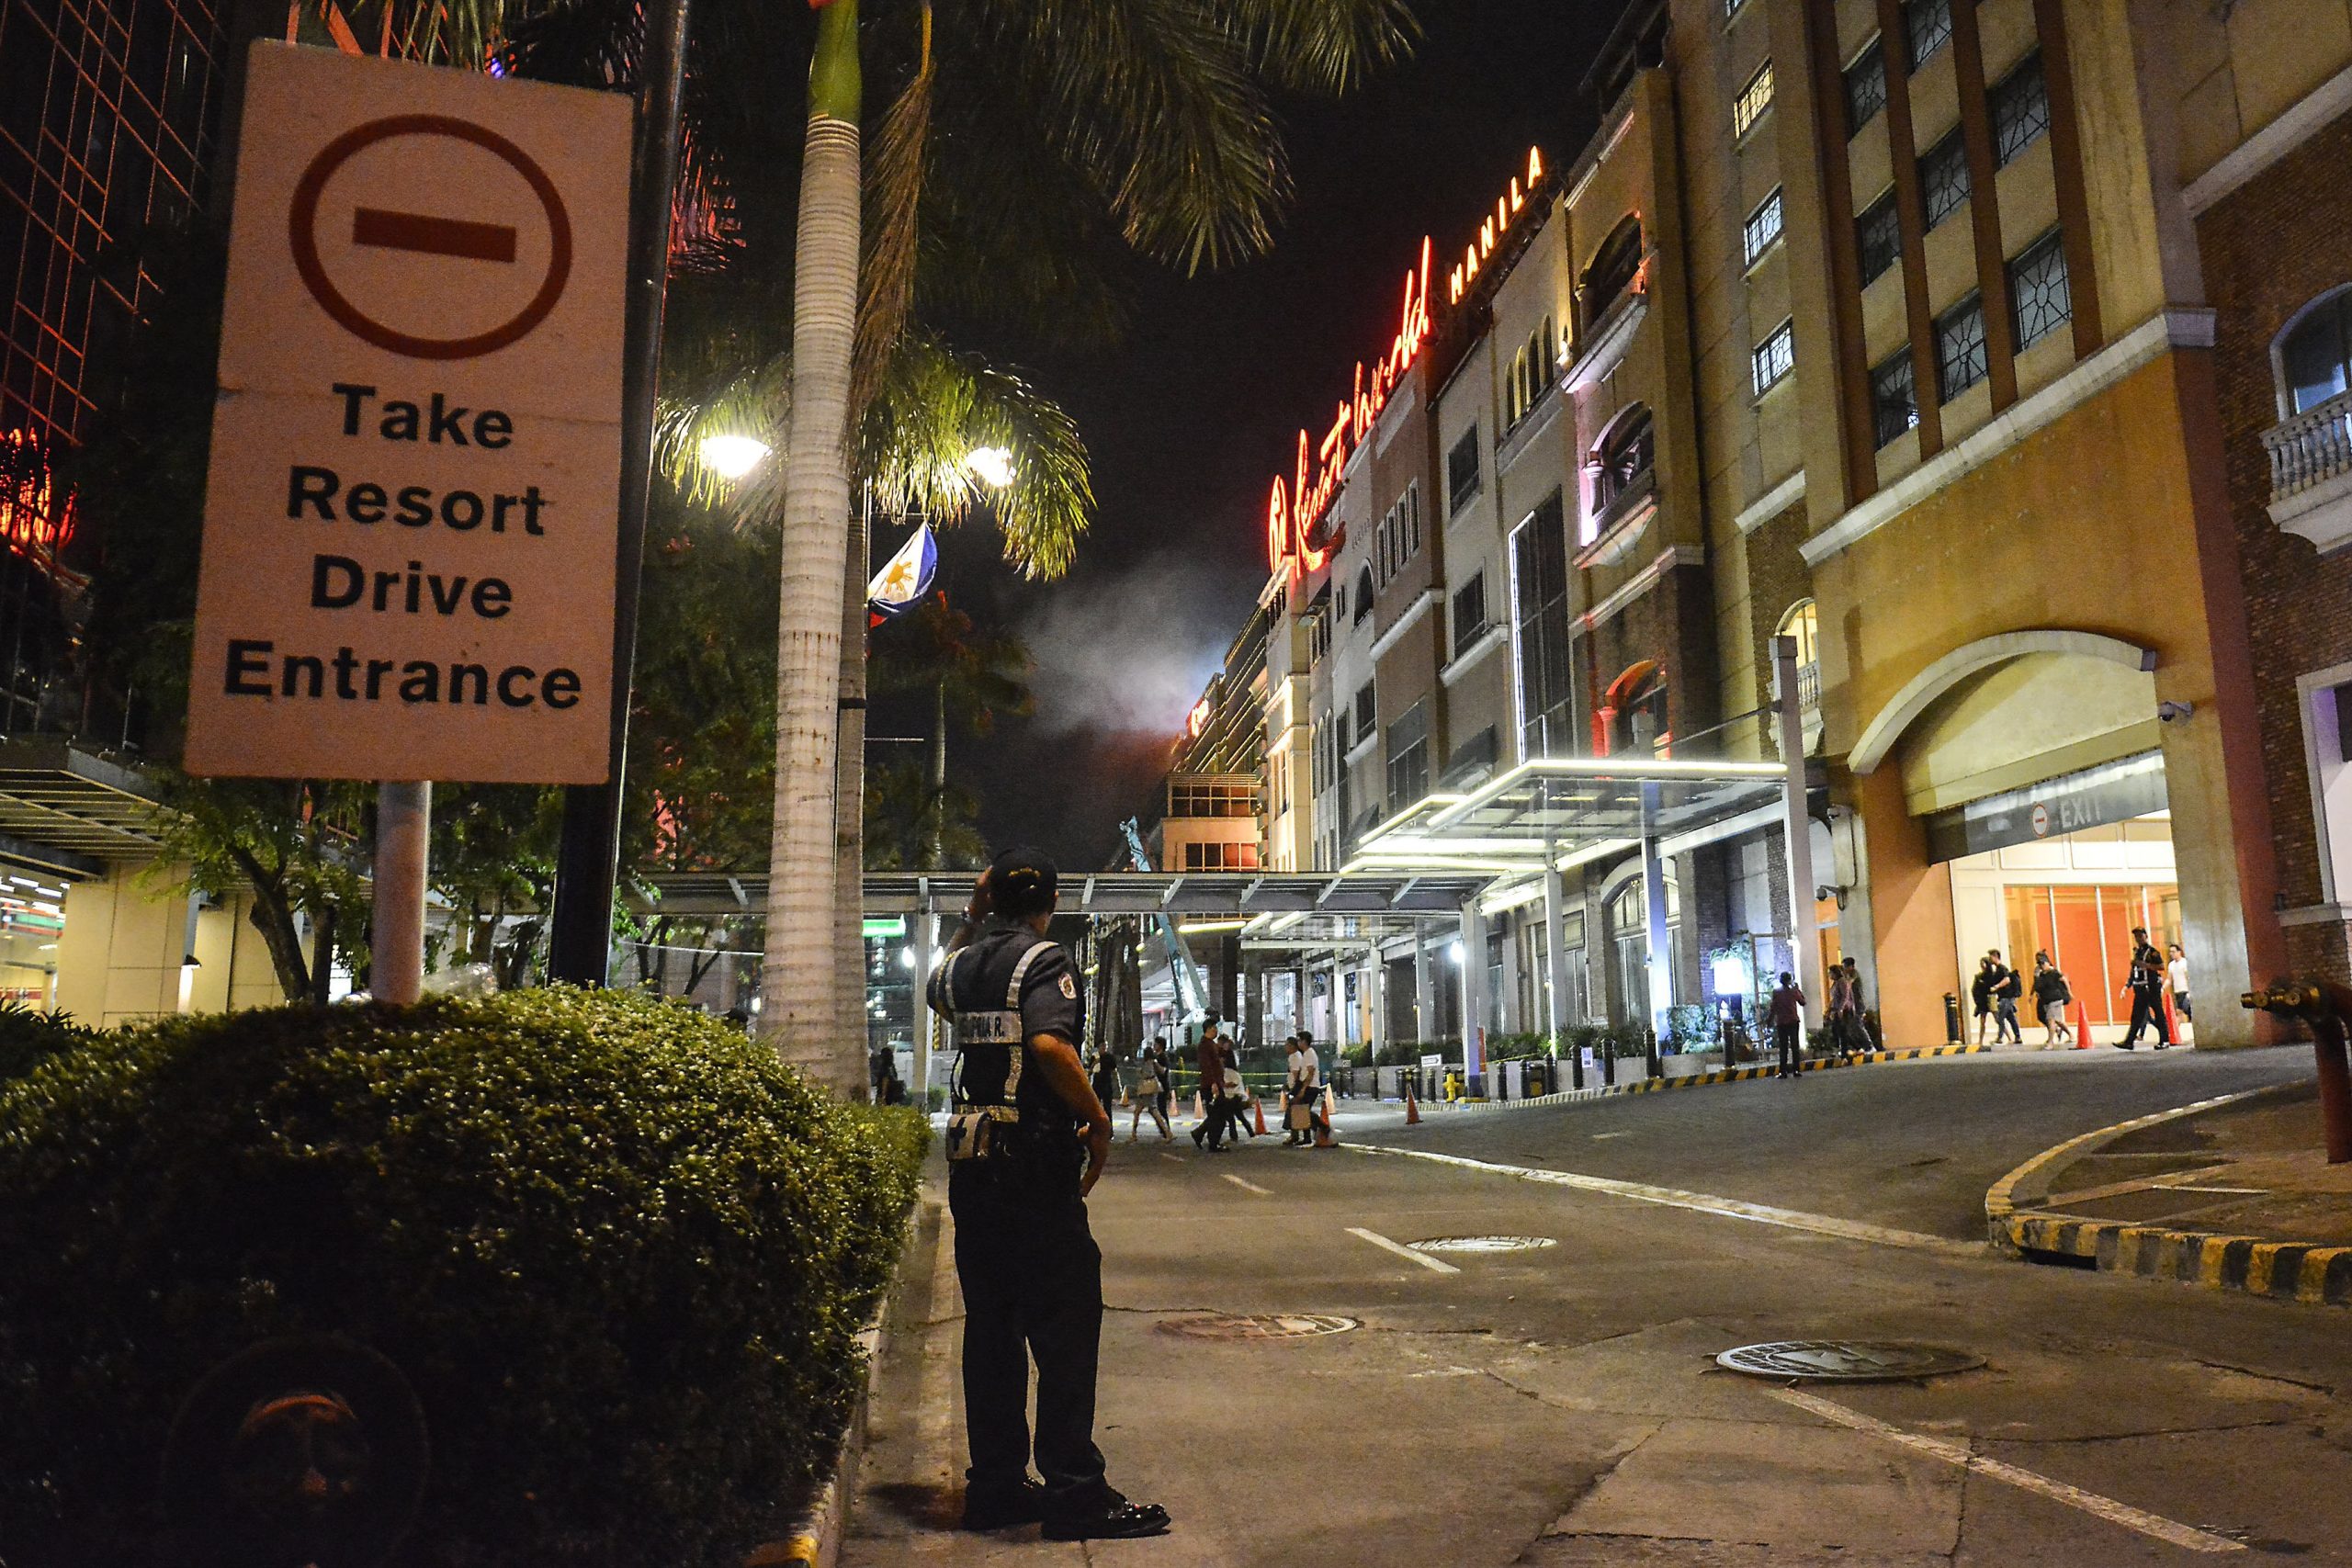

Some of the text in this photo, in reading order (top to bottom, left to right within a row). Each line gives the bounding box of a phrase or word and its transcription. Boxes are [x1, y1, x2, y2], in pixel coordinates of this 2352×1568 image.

[1451, 145, 1543, 305] MANILA
[332, 382, 514, 449] Take
[287, 465, 548, 536] Resort
[311, 554, 513, 619] Drive
[223, 639, 582, 710] Entrance
